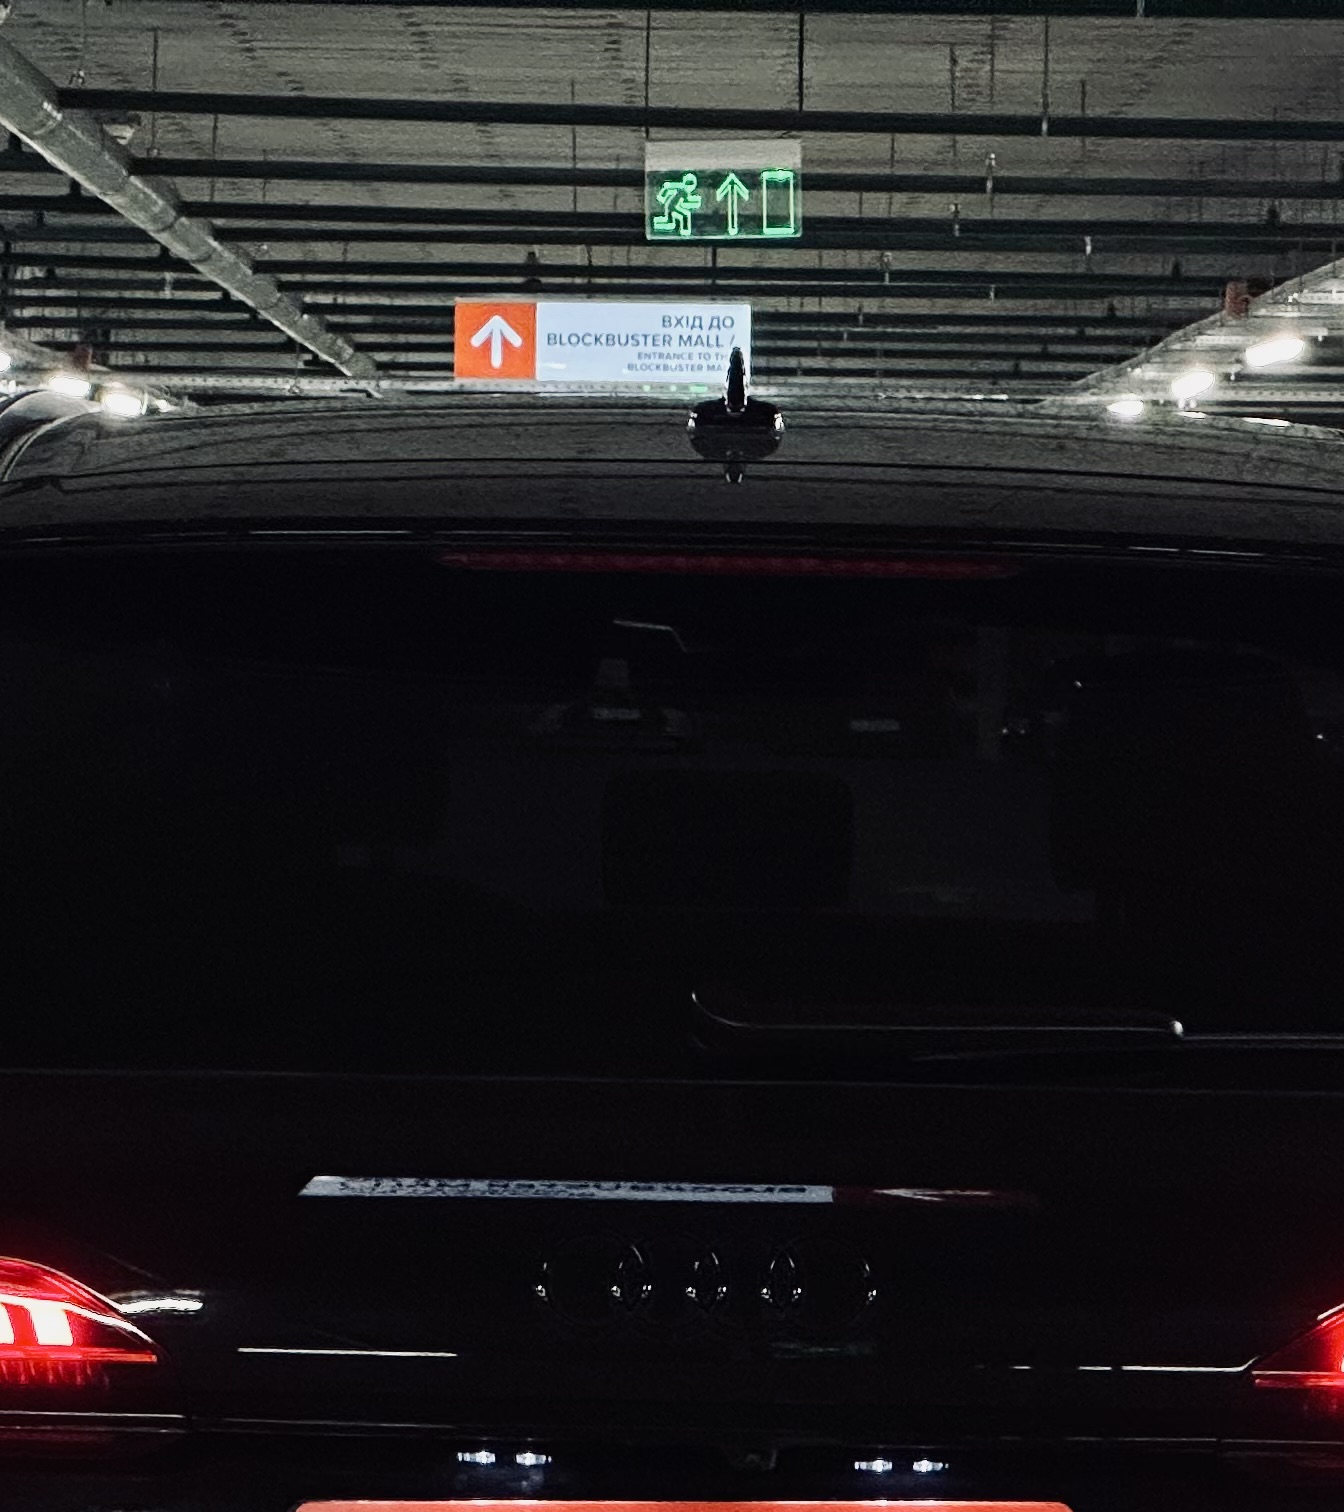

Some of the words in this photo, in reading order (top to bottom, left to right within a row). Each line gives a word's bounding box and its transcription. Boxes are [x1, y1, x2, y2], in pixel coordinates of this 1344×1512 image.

[662, 315, 704, 330] ВХІД
[709, 316, 735, 330] ДО
[547, 333, 673, 347] BLOCKBUSTER
[679, 334, 724, 348] MALL
[638, 352, 694, 361] ENTRANCE
[698, 352, 711, 361] TO
[627, 364, 704, 373] BLOCKBUSTER
